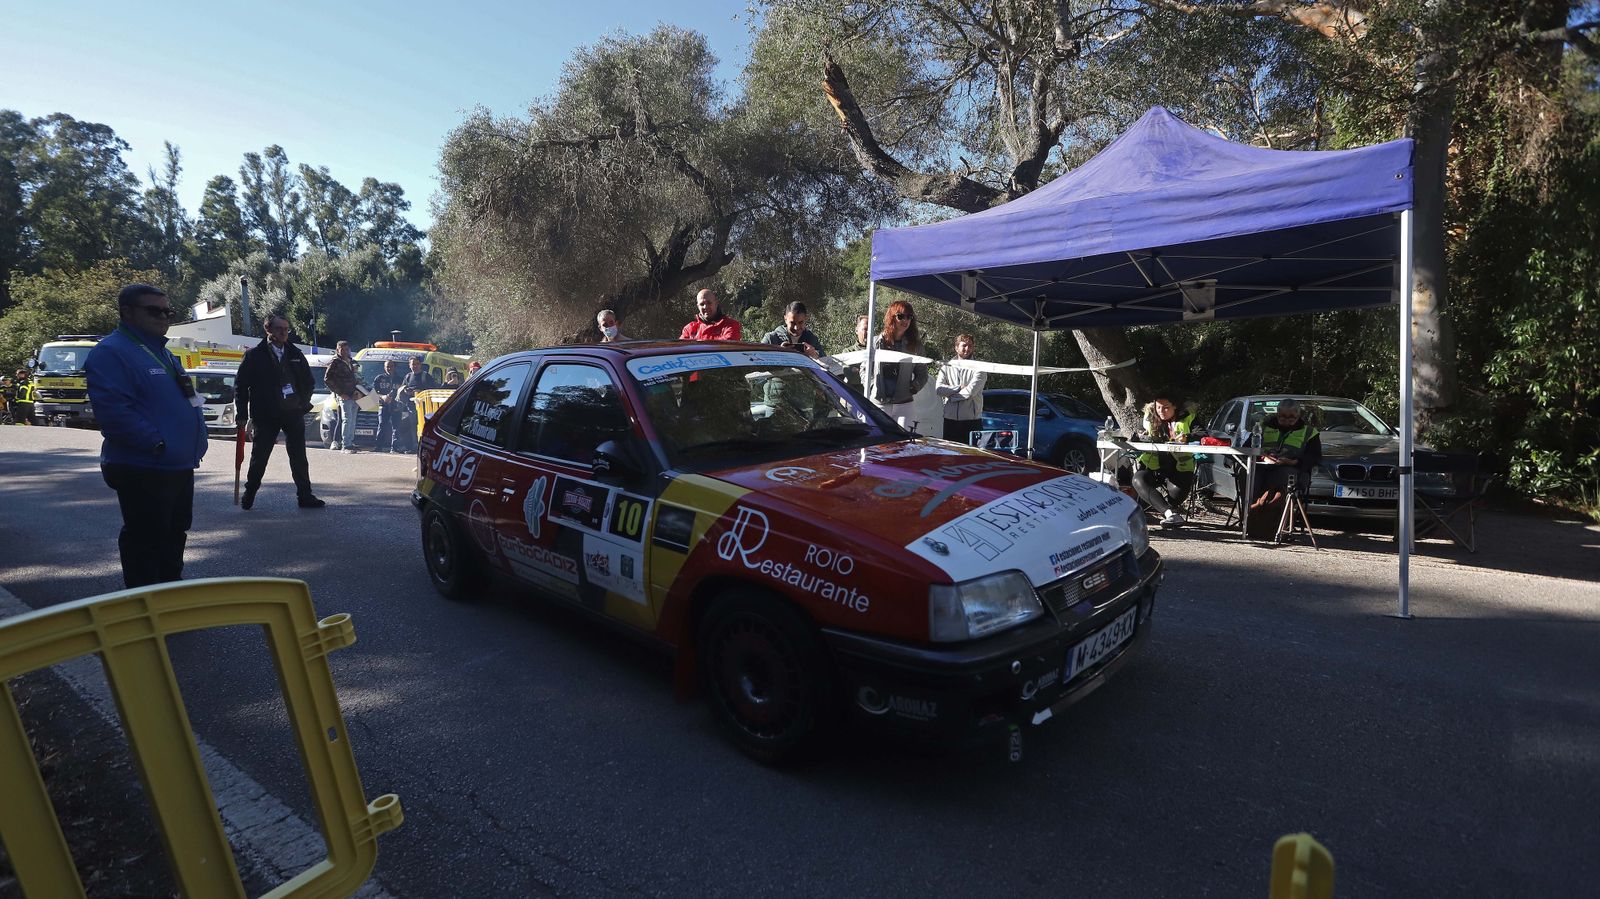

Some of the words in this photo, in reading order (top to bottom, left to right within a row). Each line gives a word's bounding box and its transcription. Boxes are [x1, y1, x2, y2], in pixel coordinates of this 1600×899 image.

[432, 442, 463, 478] JFS
[976, 475, 1099, 531] ESTACIONES
[1347, 487, 1375, 497] 7150
[617, 500, 642, 536] 10
[1009, 496, 1088, 541] RESTAURANTE
[718, 505, 869, 613] Restaurante
